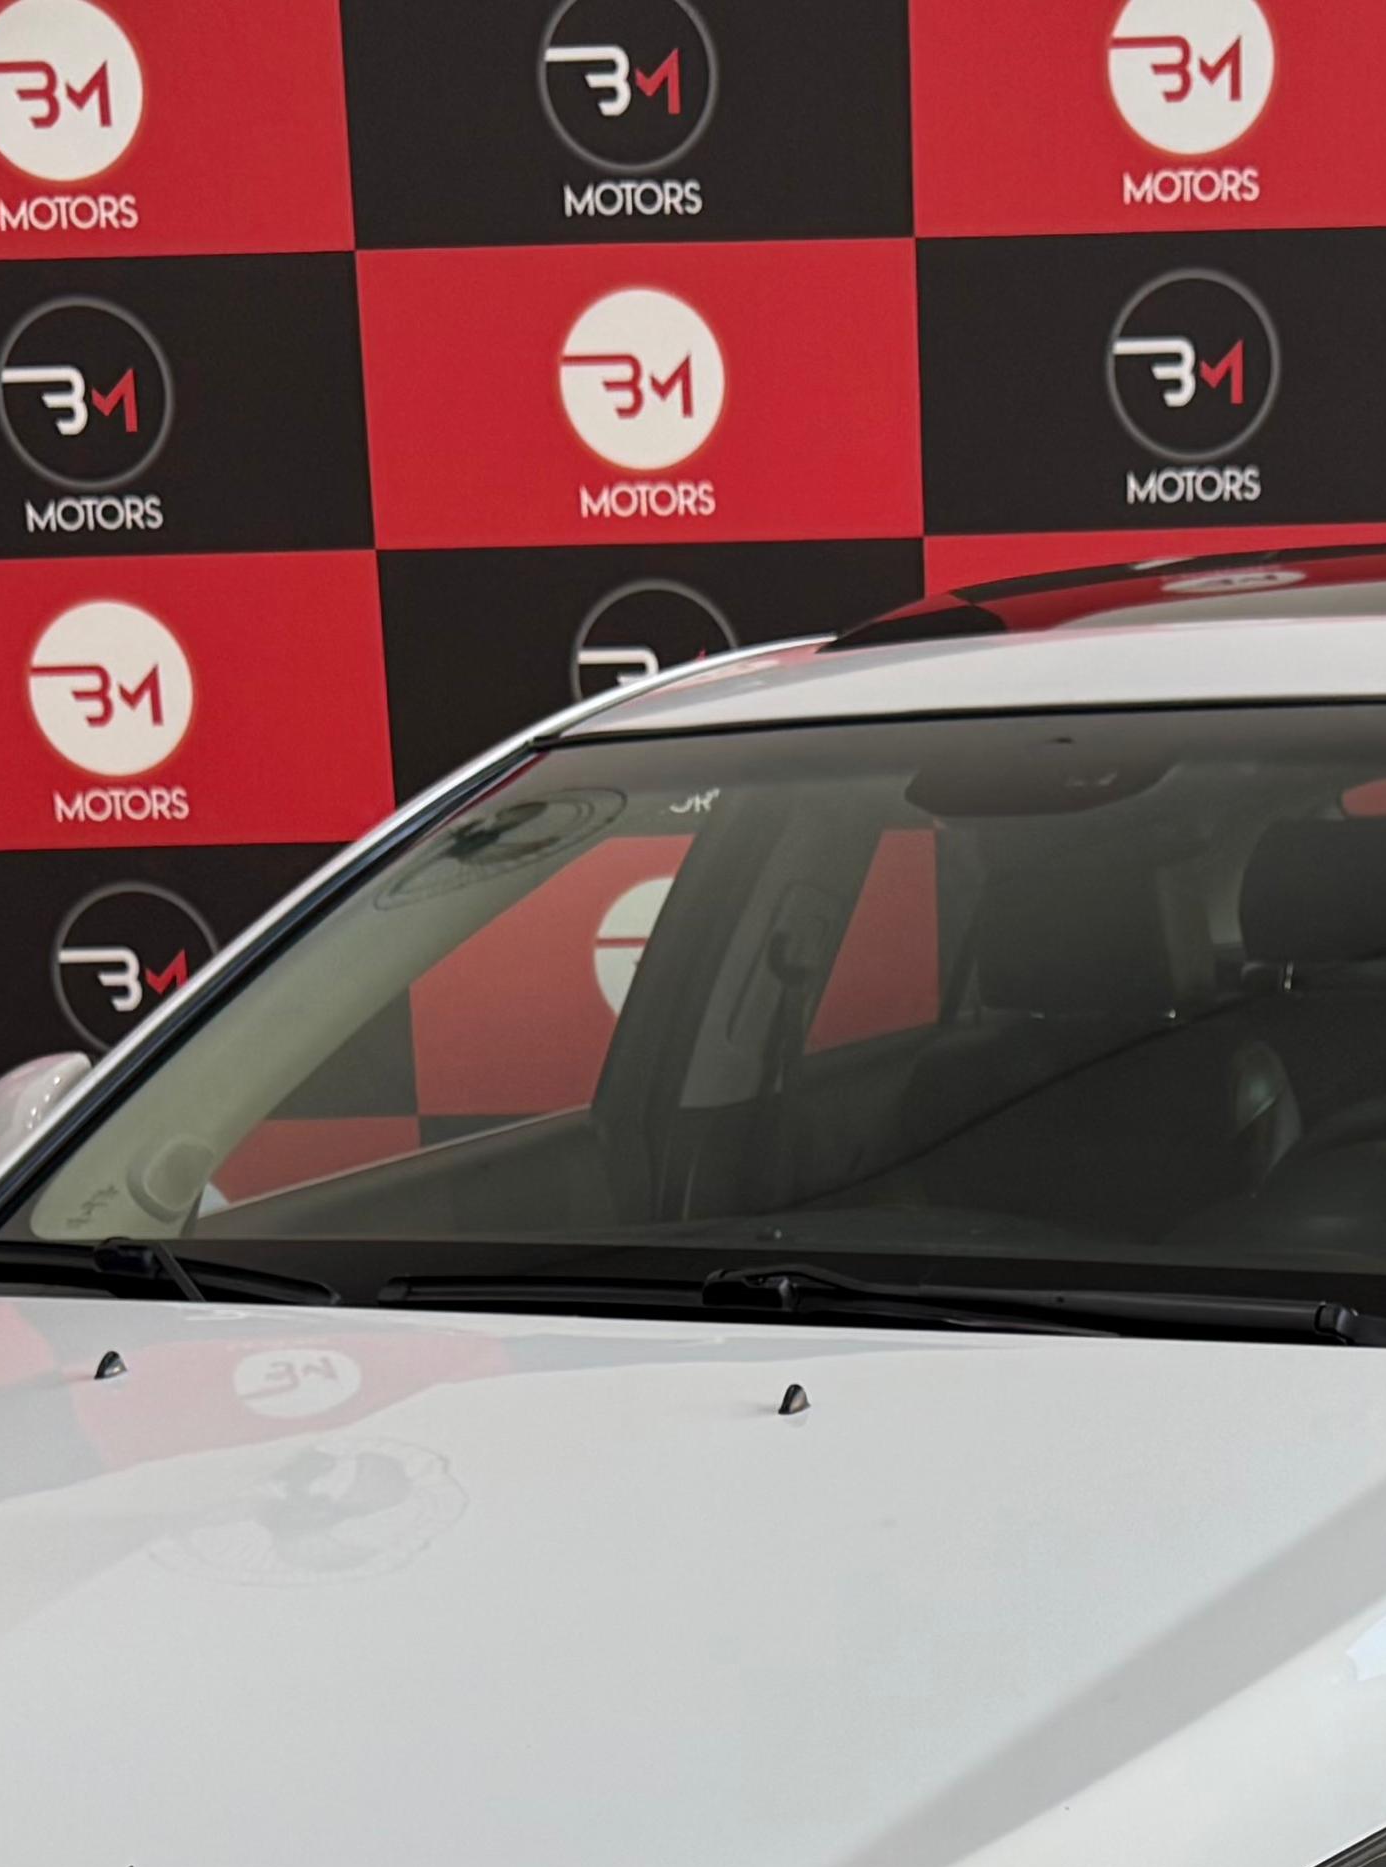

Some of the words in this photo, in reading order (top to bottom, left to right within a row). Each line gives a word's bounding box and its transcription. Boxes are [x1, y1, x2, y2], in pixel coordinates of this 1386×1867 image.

[563, 180, 702, 218] MOTORS
[1123, 168, 1260, 205] MOTORS
[580, 482, 716, 519] MOTORS
[1126, 467, 1261, 504] MOTORS
[25, 496, 163, 534] MOTORS
[53, 788, 189, 824] MOTORS
